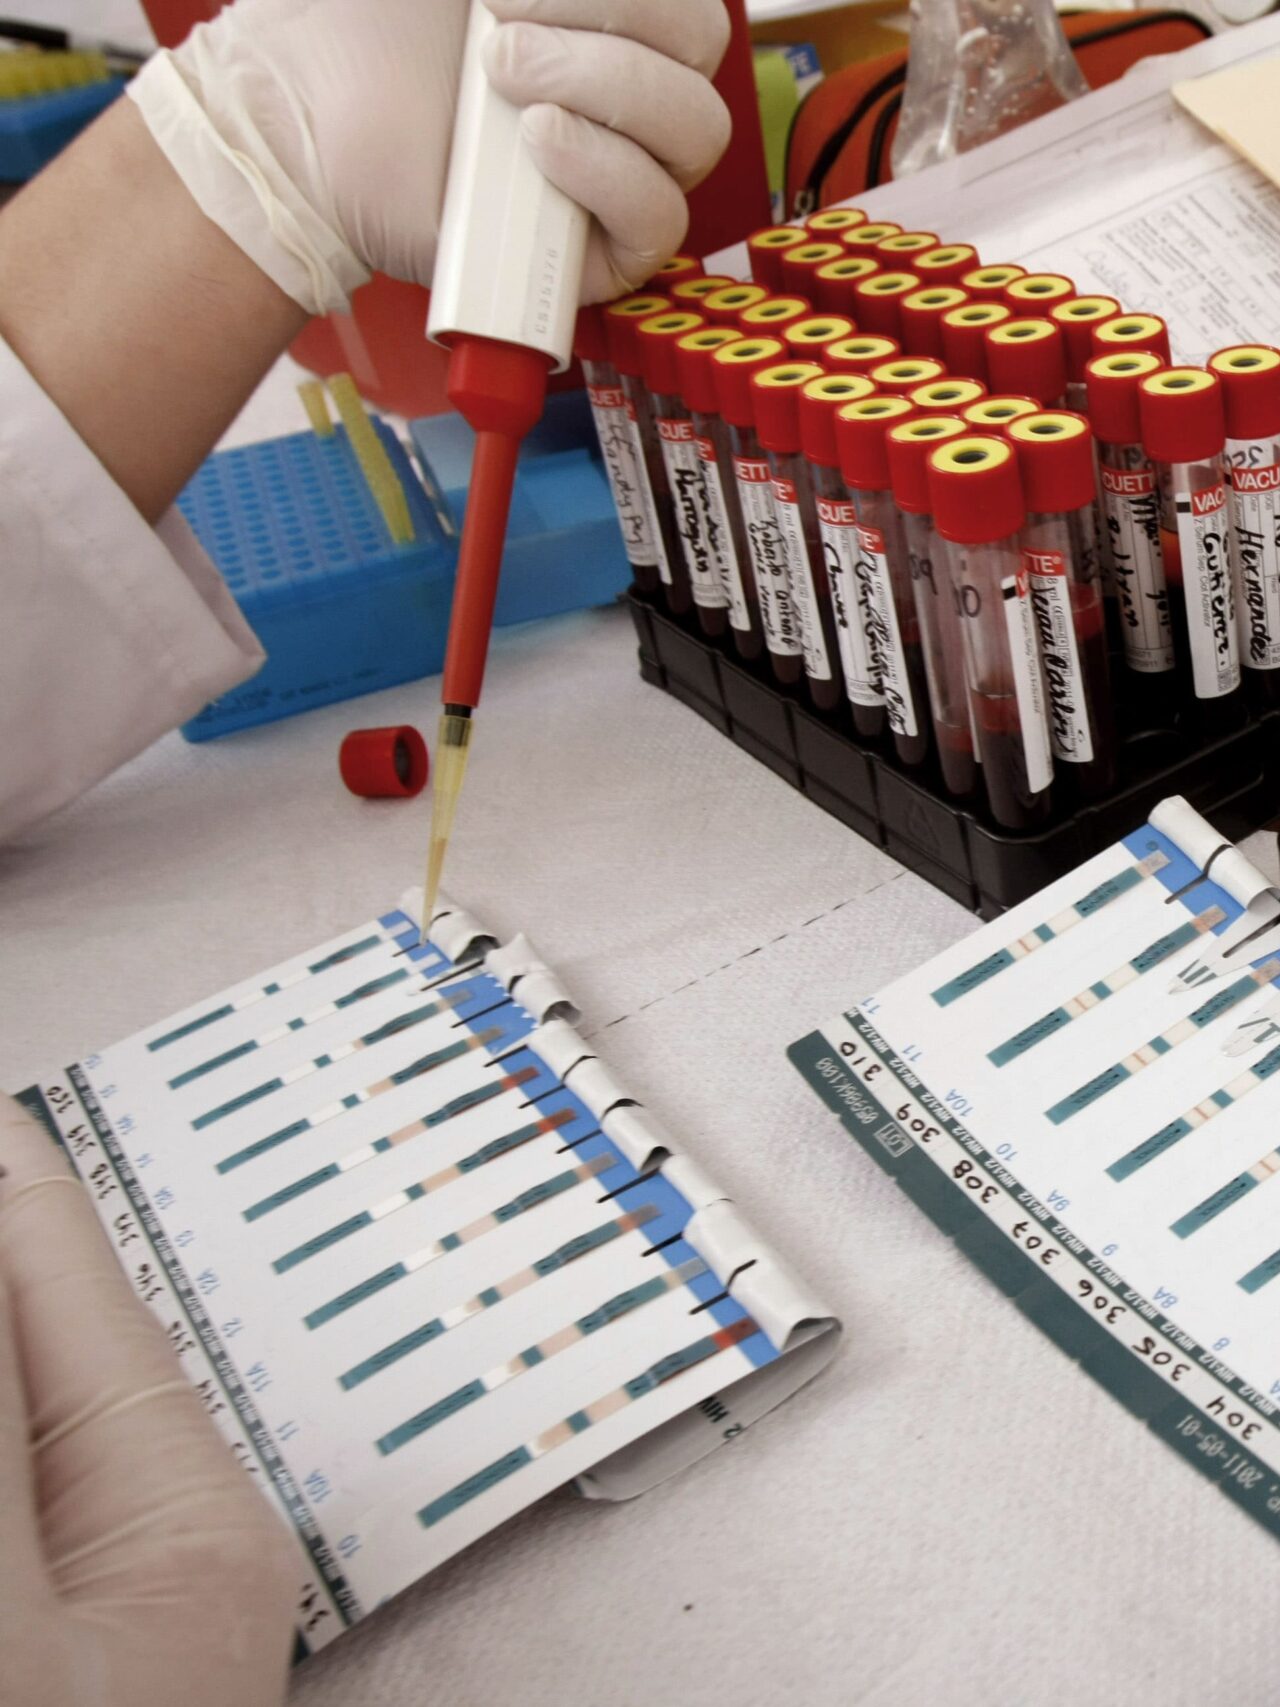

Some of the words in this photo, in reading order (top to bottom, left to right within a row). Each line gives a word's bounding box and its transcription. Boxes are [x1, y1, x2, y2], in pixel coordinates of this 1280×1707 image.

[839, 1041, 883, 1082] 310
[943, 1088, 974, 1117] 10A
[896, 1103, 941, 1143] 309
[995, 1143, 1018, 1162] 10
[952, 1159, 999, 1204] 308
[1047, 1189, 1070, 1212] 9A
[1012, 1221, 1060, 1265] 307
[1078, 1279, 1127, 1324] 306
[1152, 1286, 1179, 1309] 8A
[1131, 1336, 1192, 1382] 305
[1212, 1337, 1231, 1352] 8
[1206, 1396, 1263, 1441] 304
